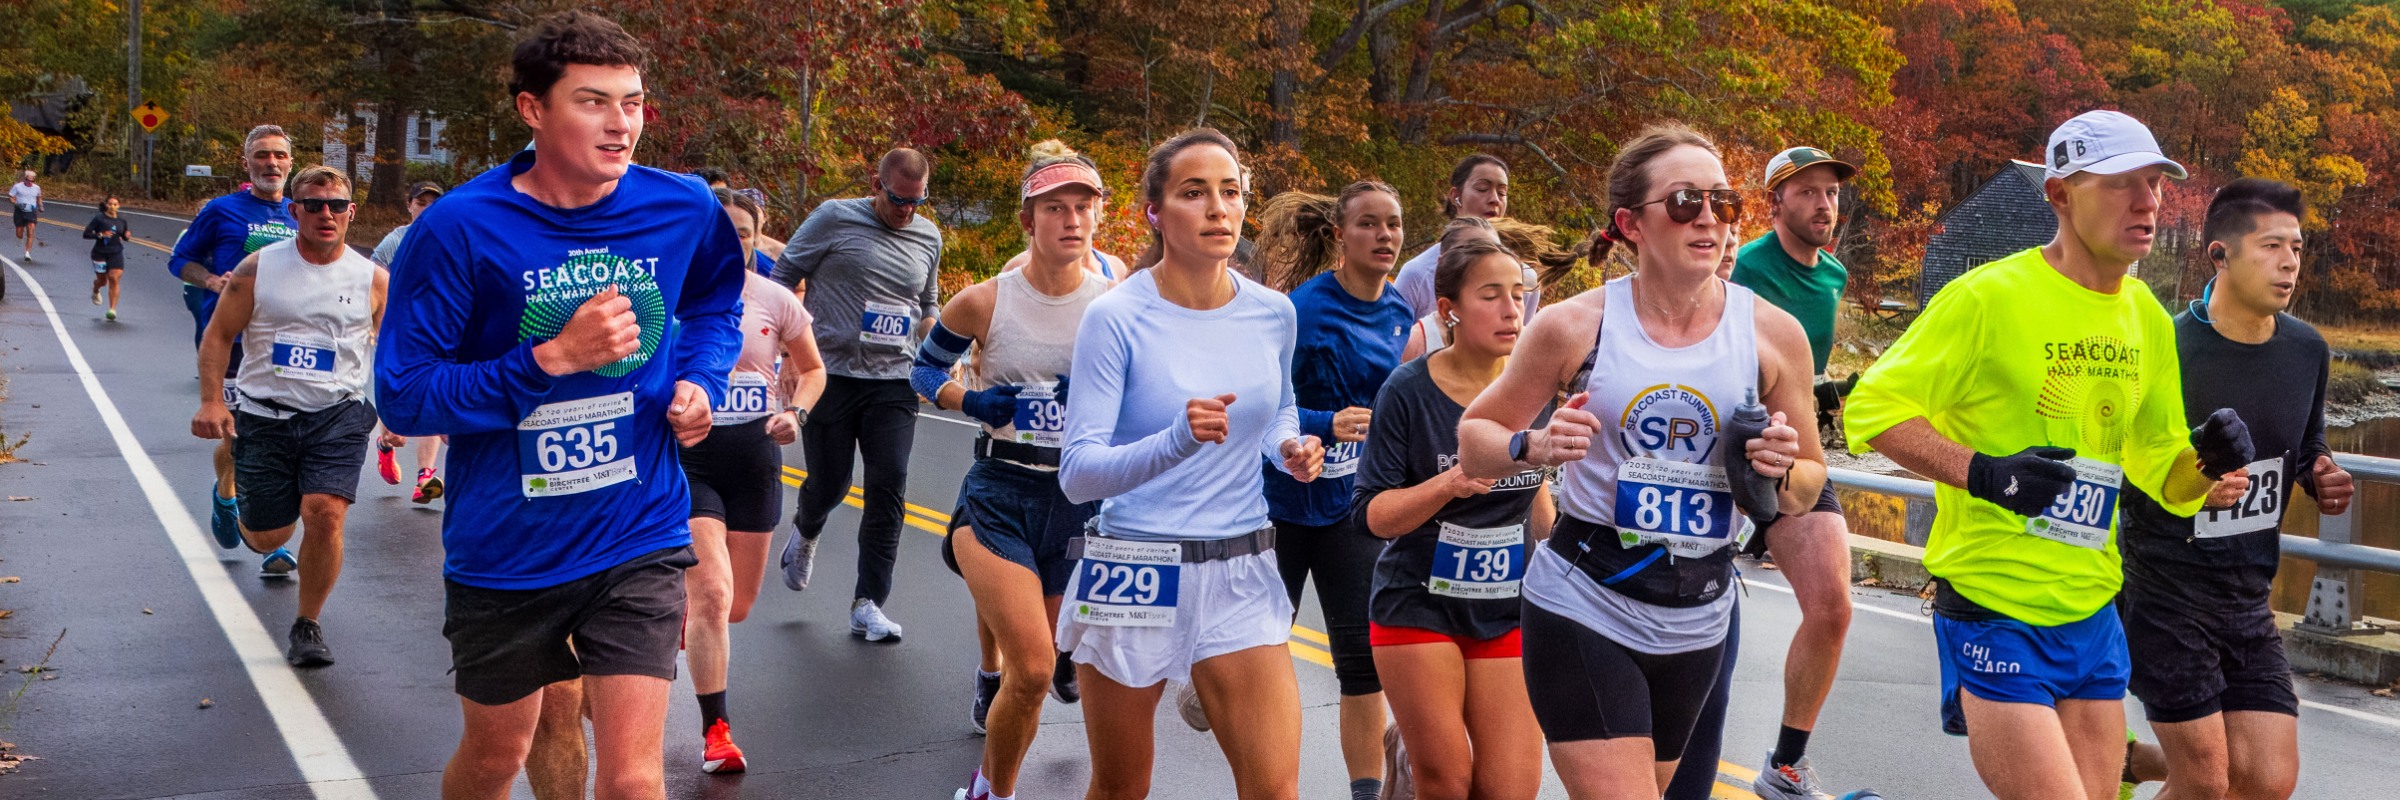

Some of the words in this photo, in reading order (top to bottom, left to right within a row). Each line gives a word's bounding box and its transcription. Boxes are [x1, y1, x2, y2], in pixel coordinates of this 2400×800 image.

[2075, 140, 2086, 157] B
[247, 222, 299, 237] SEACOAS
[567, 248, 584, 257] 20th
[584, 245, 609, 255] Annual
[522, 257, 659, 291] SEACOAST
[525, 292, 558, 303] HALF
[561, 283, 628, 300] MARATHN
[633, 280, 659, 292] 2025
[871, 314, 904, 335] 406
[288, 345, 318, 369] 85
[2044, 342, 2140, 366] SEACOAST
[2046, 364, 2082, 377] HALF
[523, 417, 560, 428] SEACOAST
[562, 413, 584, 423] HALF
[584, 406, 627, 420] MARATHON
[1028, 400, 1066, 431] 39
[1626, 389, 1678, 431] SEACOAST
[1680, 391, 1714, 436] RUNNING
[1638, 416, 1699, 451] SR
[536, 421, 618, 472] 635
[1629, 461, 1651, 470] 2025
[549, 476, 590, 488] BIRCHTREE
[1491, 472, 1543, 488] COUNTRY
[1628, 471, 1666, 482] SEACOAST
[1667, 475, 1687, 484] HALF
[1688, 478, 1728, 489] MARATHON
[1634, 486, 1713, 535] 813
[2051, 481, 2106, 526] 930
[1446, 536, 1475, 546] SEACOAST
[1112, 552, 1131, 561] HALF
[1132, 555, 1174, 563] MARATHON
[1452, 548, 1510, 582] 139
[1087, 562, 1160, 605] 229
[1090, 610, 1125, 619] BIRCHTREE
[1963, 641, 1990, 661] CHI
[1973, 659, 2021, 674] CAGO
